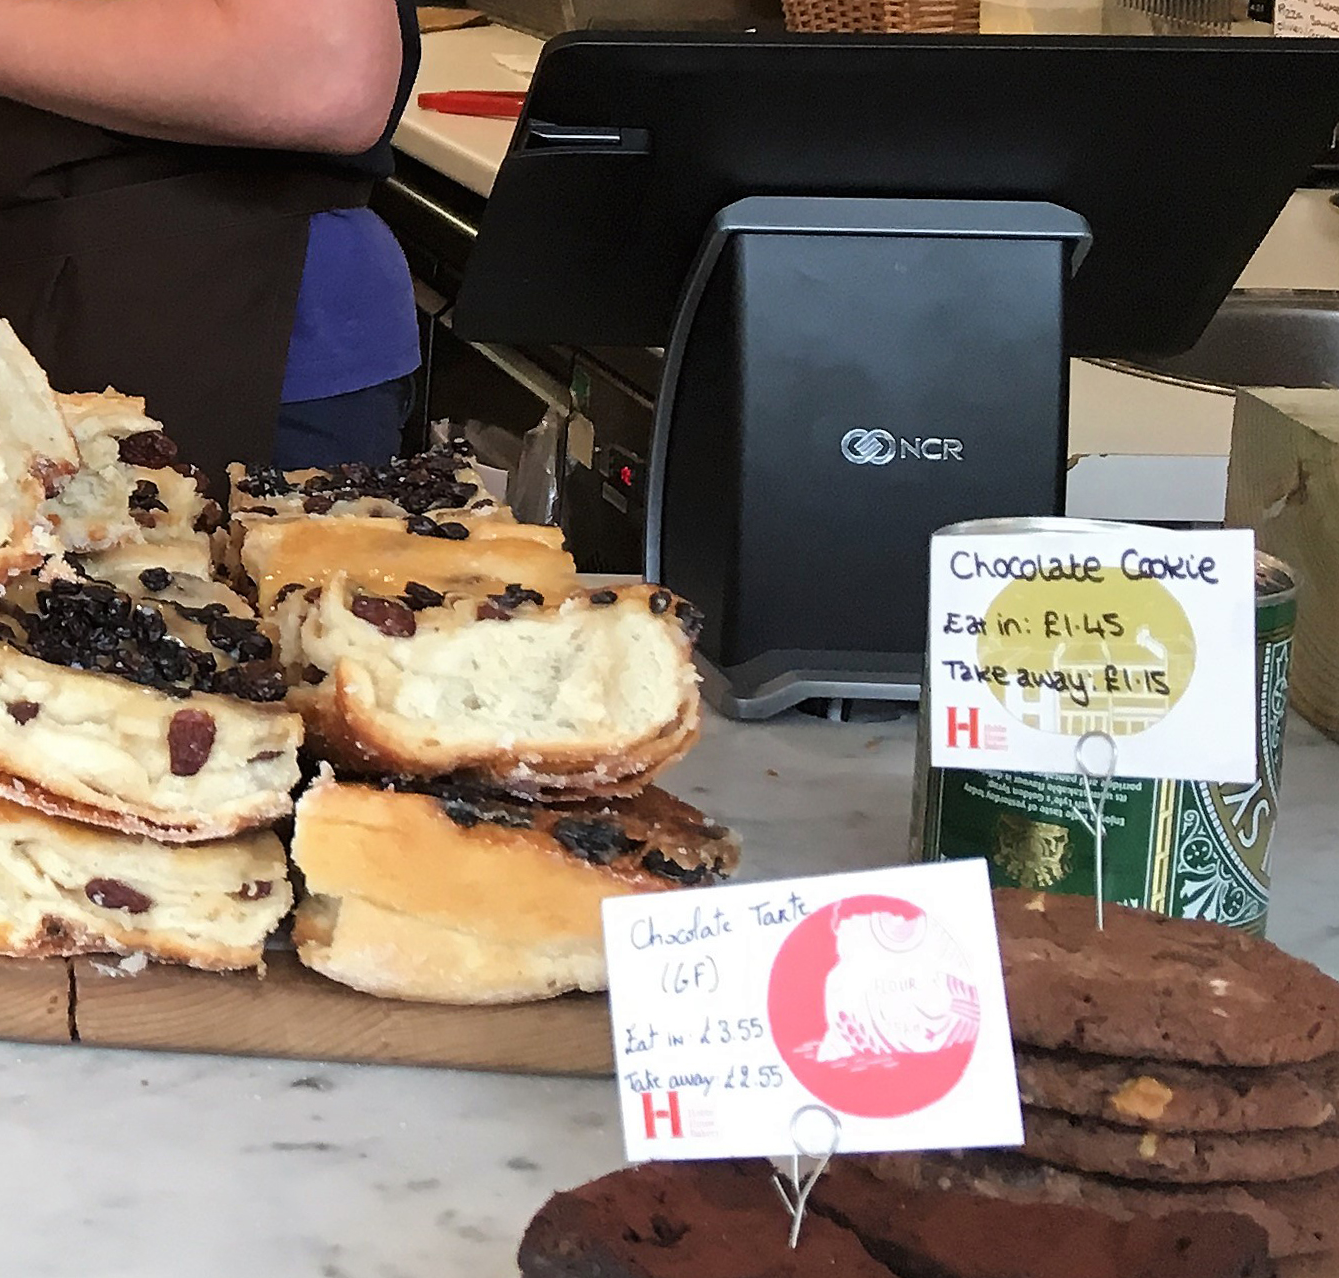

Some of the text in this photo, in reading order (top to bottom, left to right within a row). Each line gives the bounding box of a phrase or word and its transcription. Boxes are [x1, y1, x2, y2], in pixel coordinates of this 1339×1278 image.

[900, 437, 964, 460] NCR
[950, 549, 1219, 584] Chocolate Cookie
[943, 612, 987, 635] Eat
[1044, 611, 1125, 638] £1.45
[942, 660, 1010, 685] Take
[1105, 664, 1170, 695] £1.15
[946, 706, 980, 749] H
[631, 907, 733, 951] Chocolate
[625, 1024, 659, 1055] Eat
[625, 1068, 662, 1094] Take
[640, 1091, 685, 1140] H
